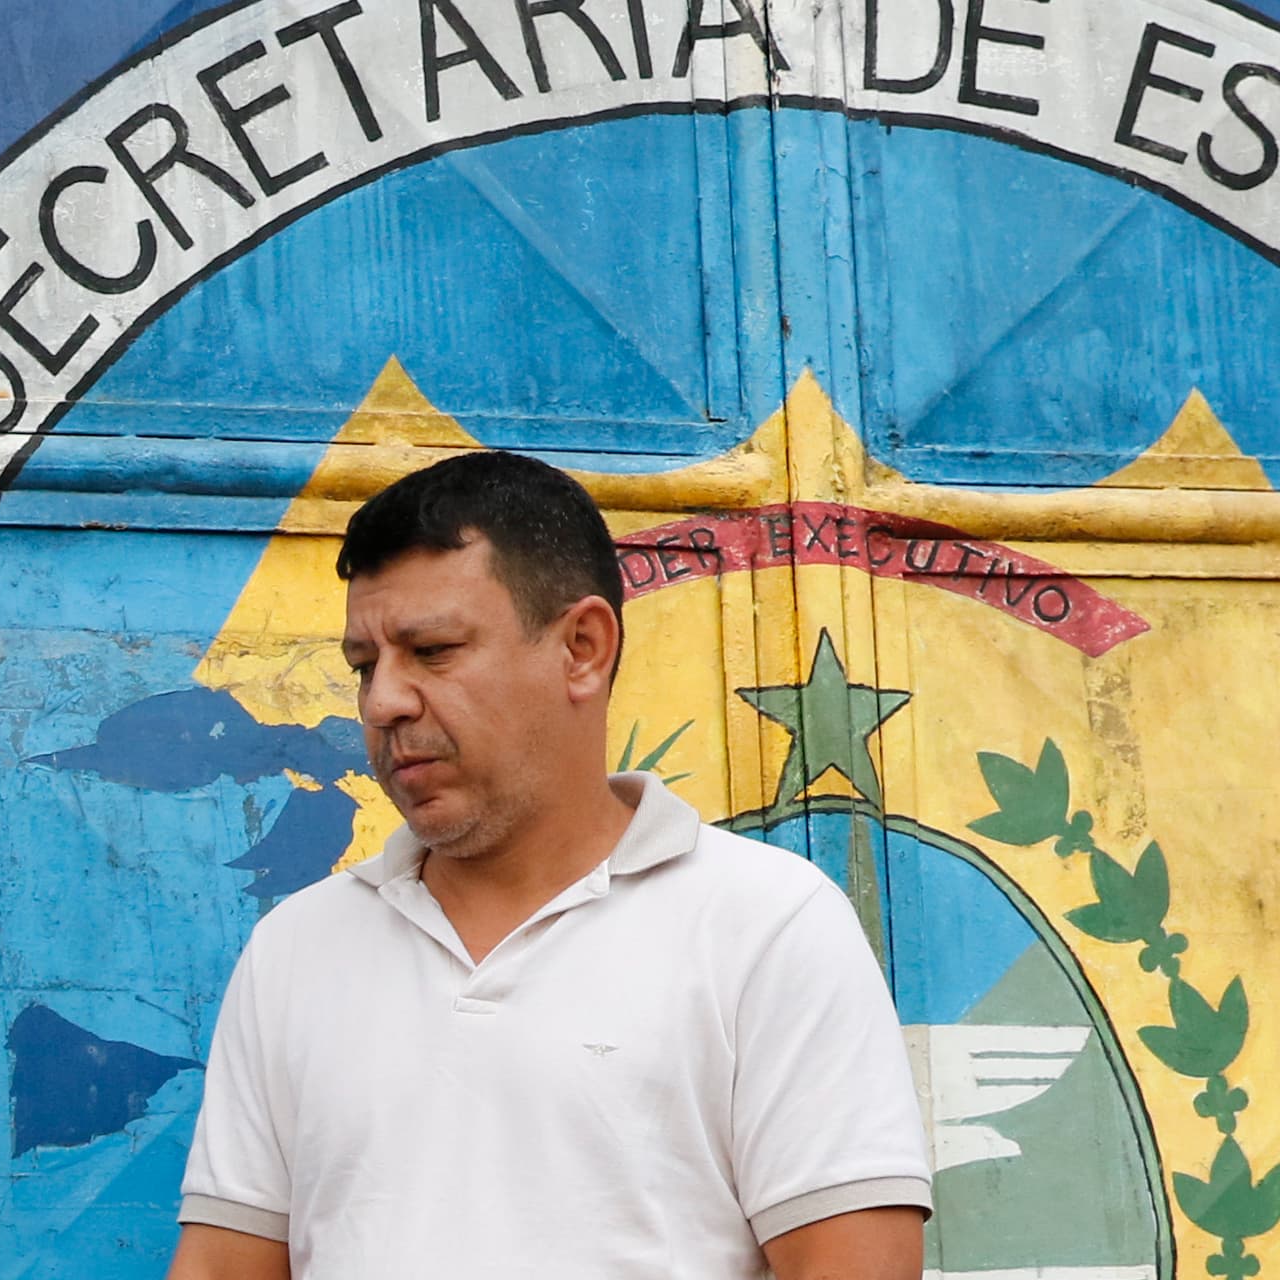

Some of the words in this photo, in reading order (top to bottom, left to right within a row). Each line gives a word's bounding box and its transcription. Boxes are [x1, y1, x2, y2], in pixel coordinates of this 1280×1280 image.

[863, 0, 1046, 117] DE
[617, 527, 724, 589] DER
[760, 513, 1072, 623] EXECUTIVO
